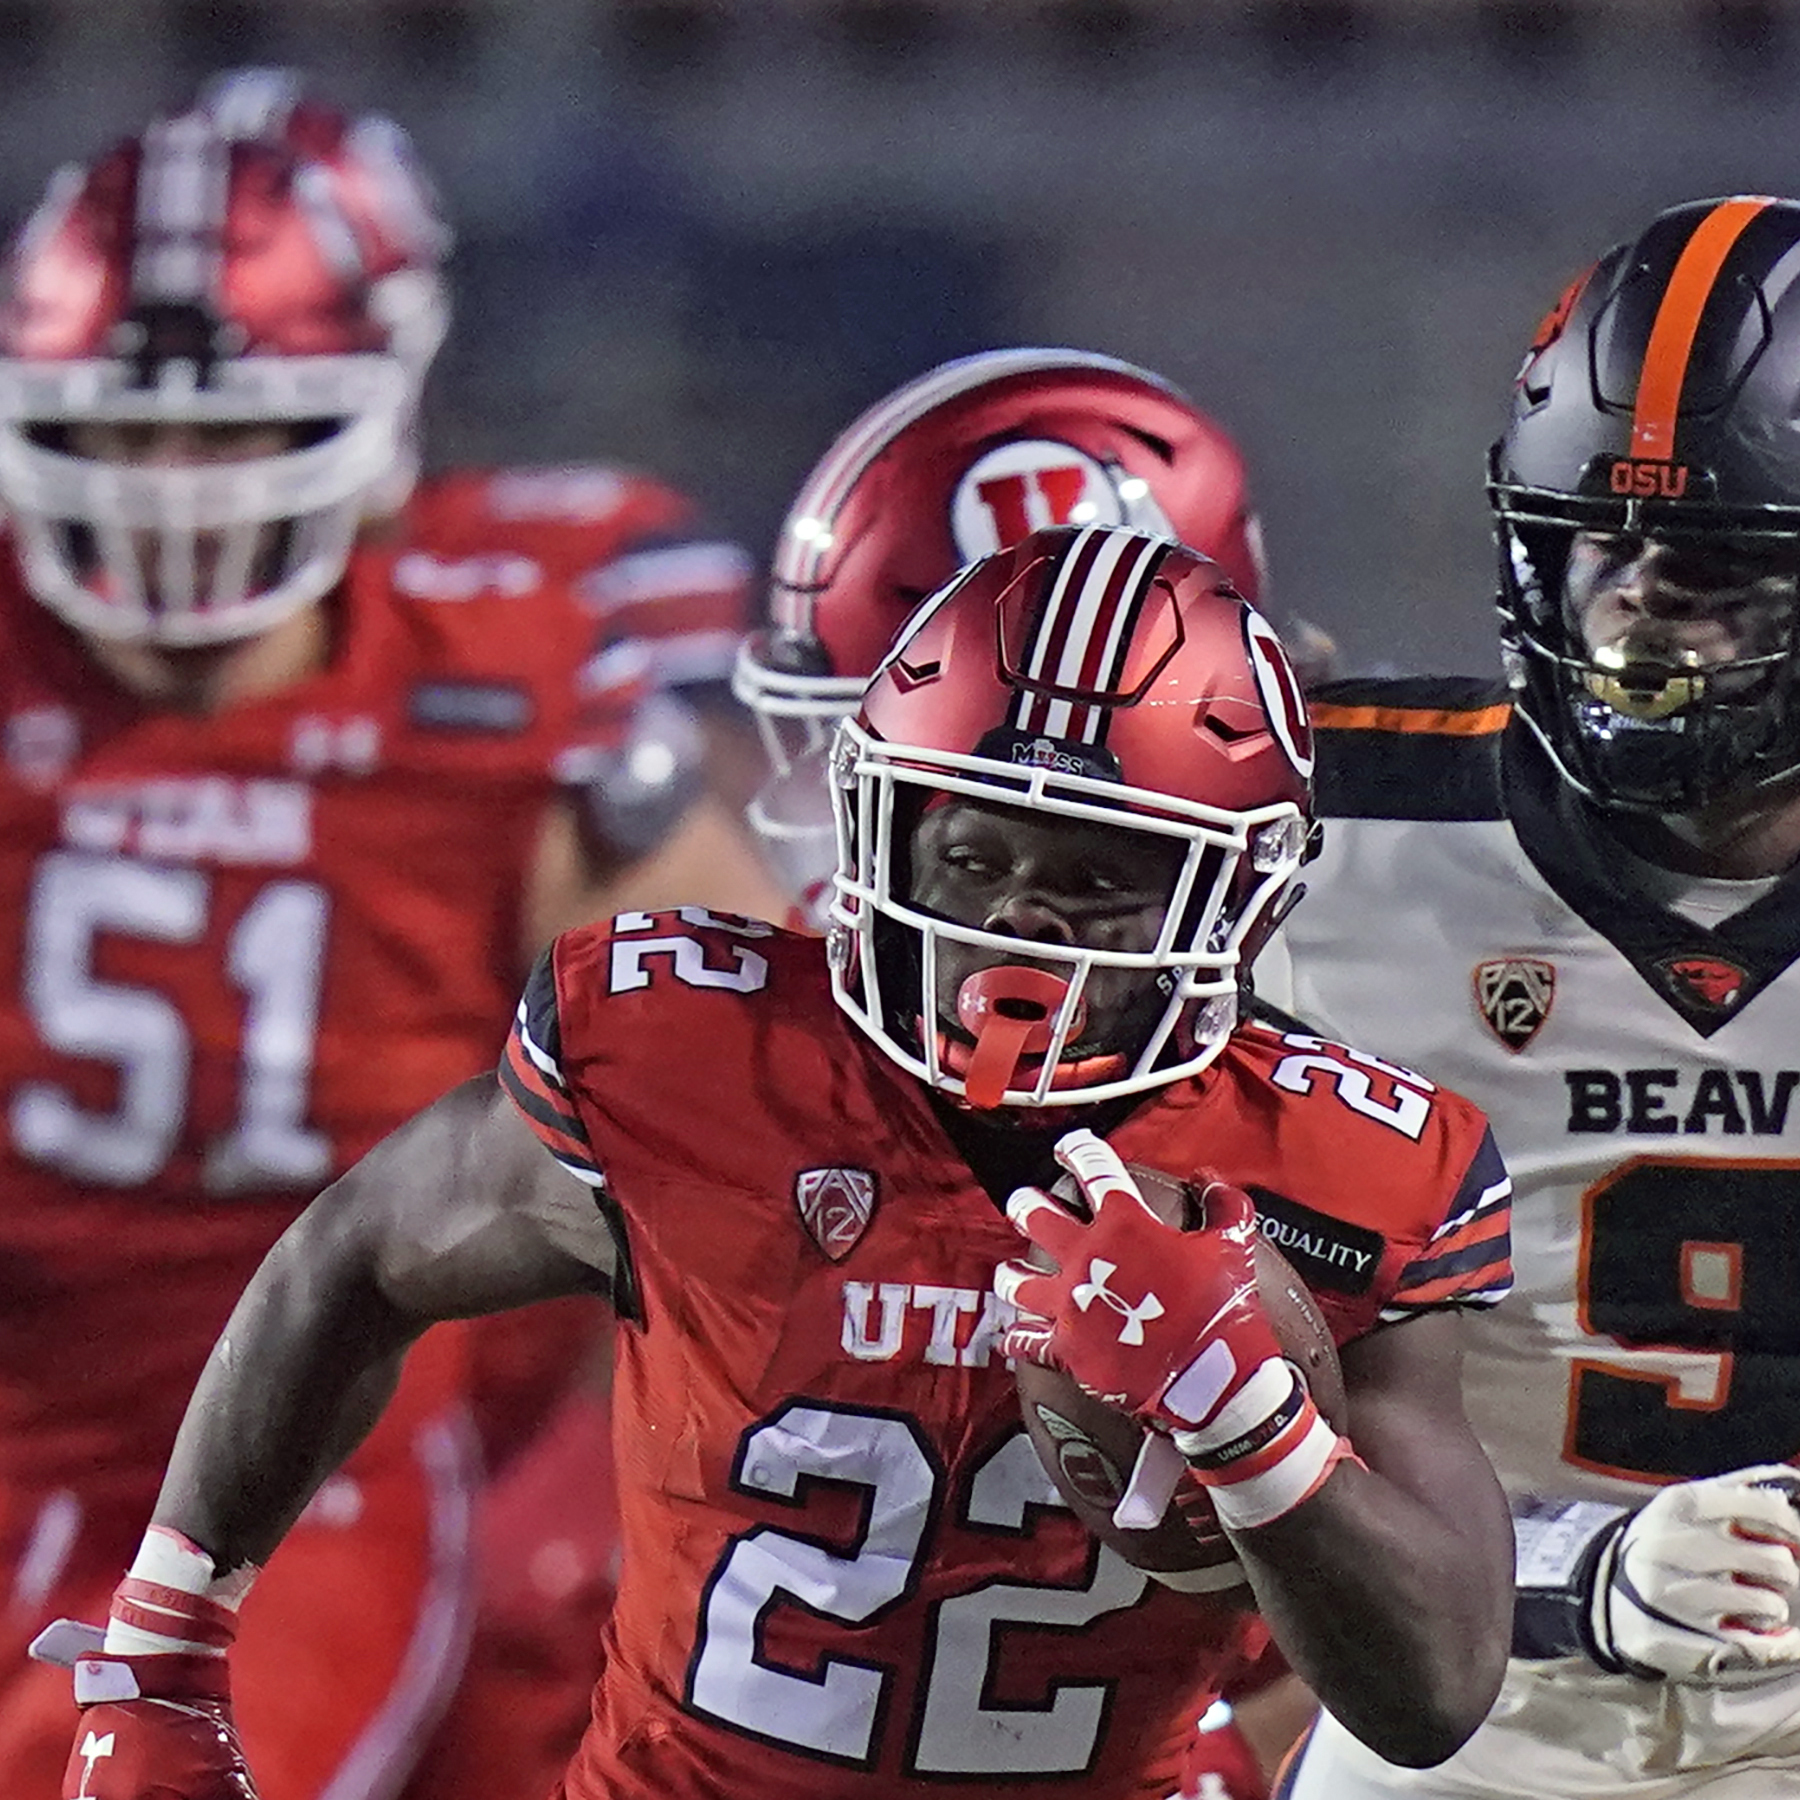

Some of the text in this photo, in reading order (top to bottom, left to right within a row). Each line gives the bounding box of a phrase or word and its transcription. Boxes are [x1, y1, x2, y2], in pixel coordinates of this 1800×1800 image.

[1610, 462, 1688, 497] OSU
[12, 850, 335, 1192] 51
[1496, 998, 1537, 1034] 12
[816, 1206, 857, 1243] 12
[840, 1280, 1018, 1372] UTA
[682, 1395, 1150, 1782] 22
